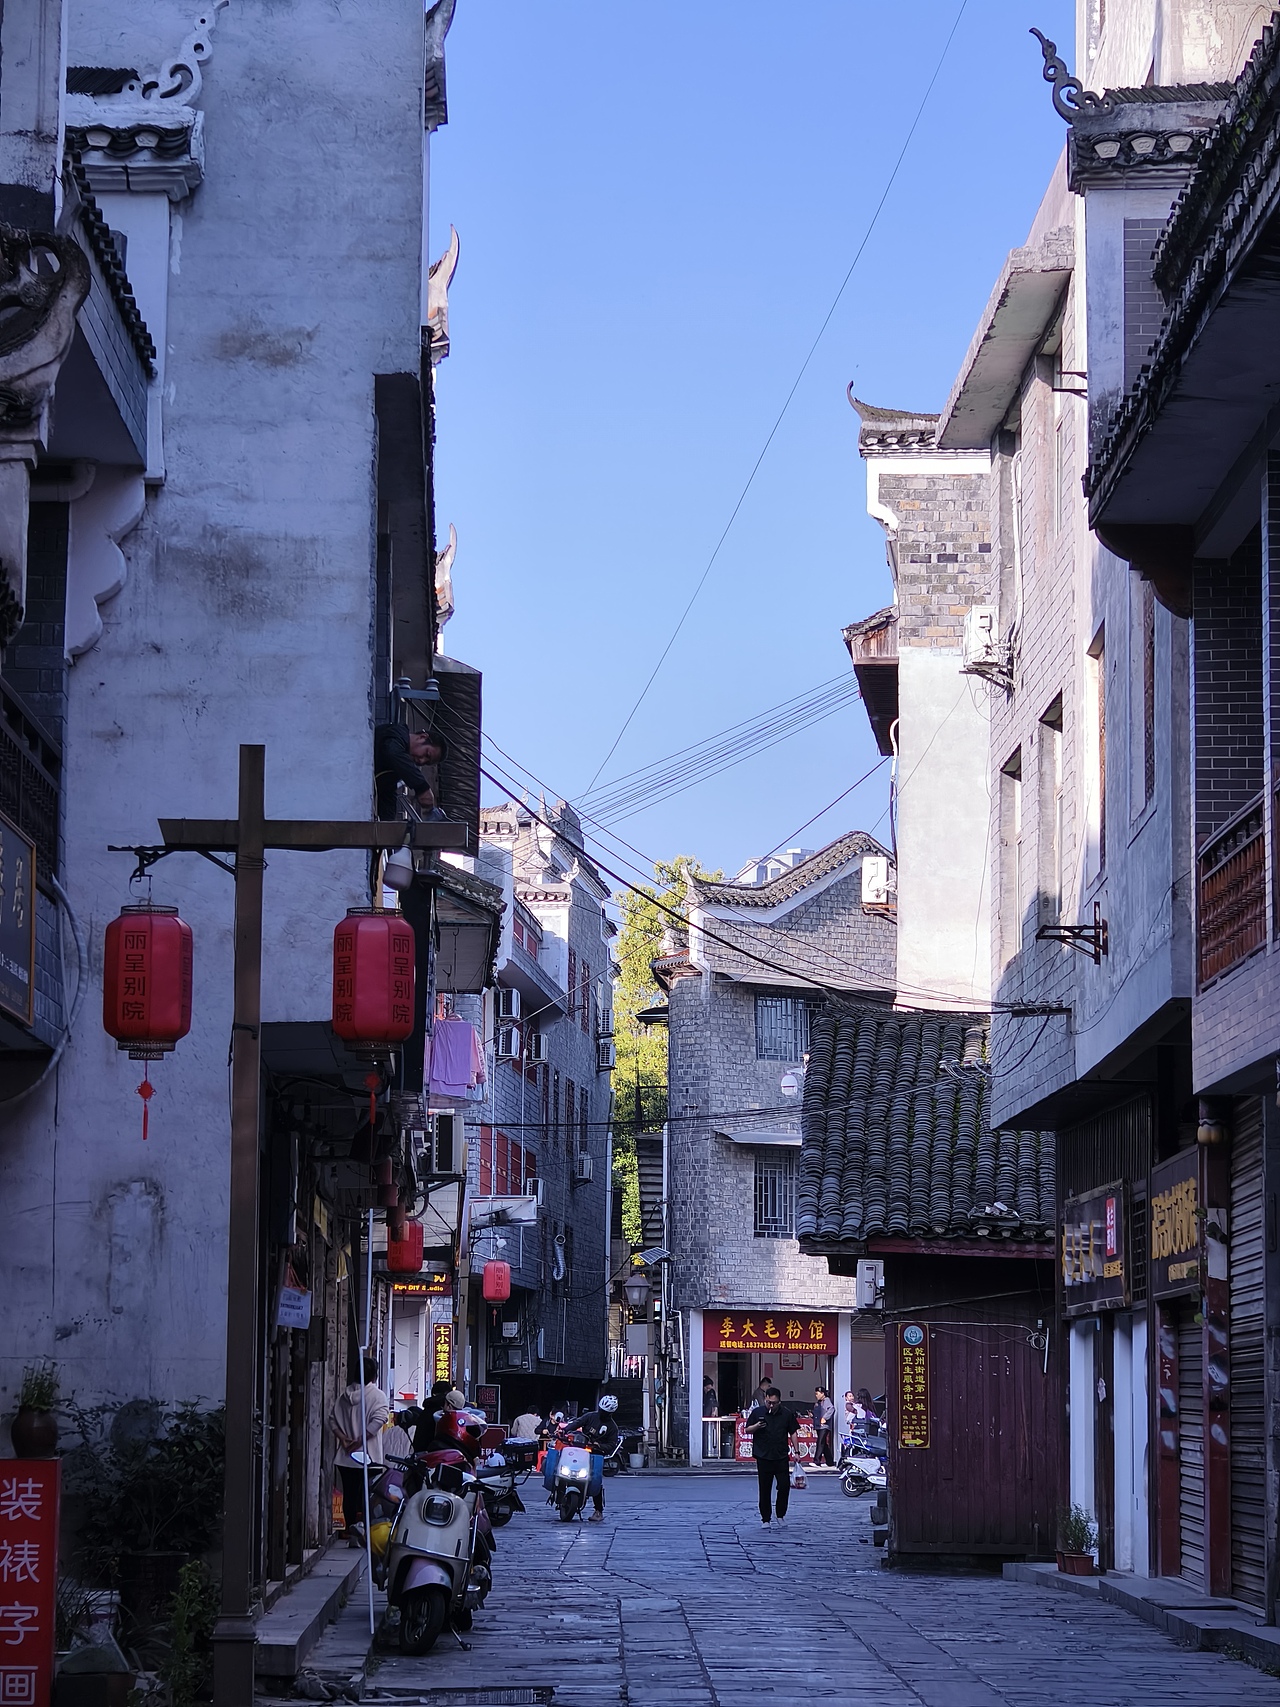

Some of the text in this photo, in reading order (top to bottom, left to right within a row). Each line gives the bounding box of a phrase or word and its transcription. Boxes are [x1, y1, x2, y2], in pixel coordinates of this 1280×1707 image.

[122, 930, 146, 1021] 丽呈别院
[336, 933, 353, 1023] 丽呈别院
[392, 933, 411, 1024] 丽呈别院
[719, 1316, 825, 1340] 李大毛粉馆
[902, 1347, 914, 1411] 区卫生服务中心
[914, 1347, 926, 1411] 乾州街道第一社
[0, 1477, 44, 1706] 装裱字画
